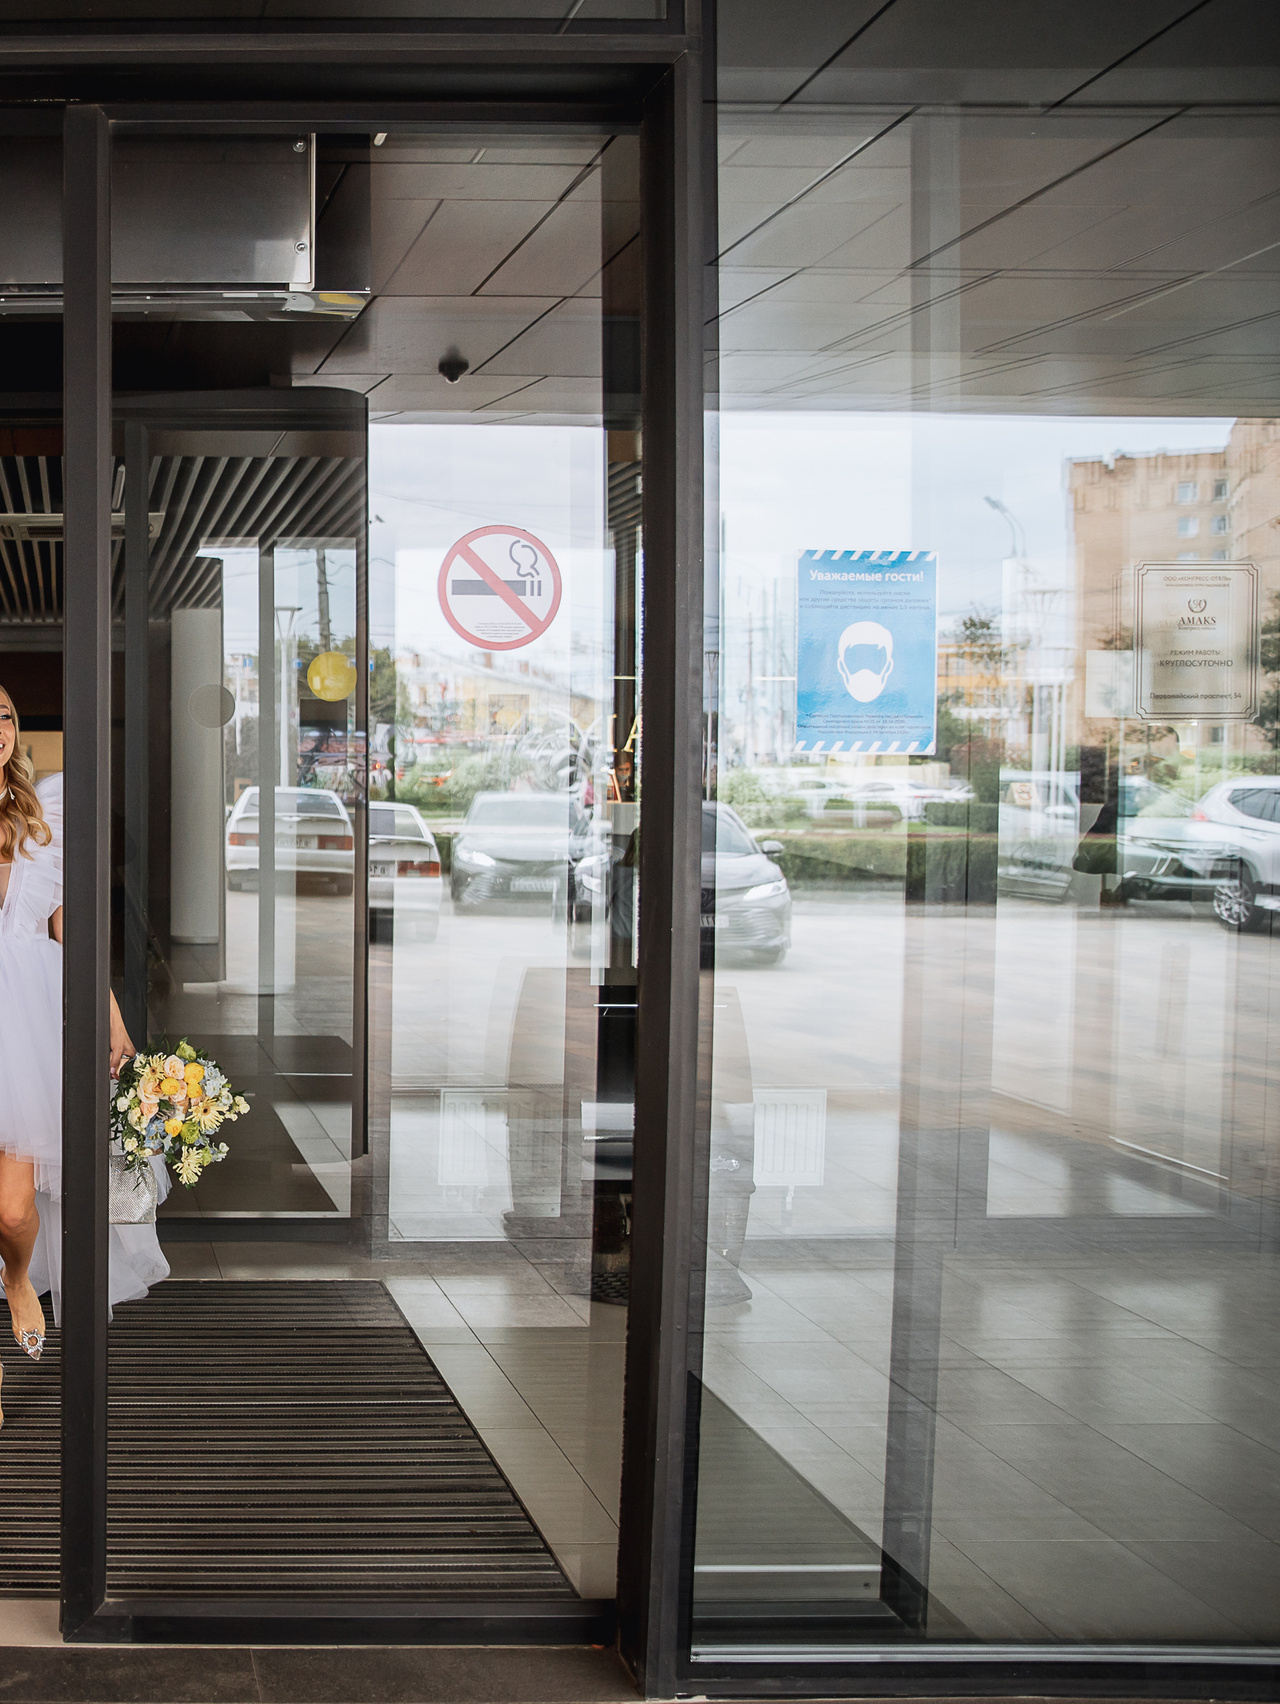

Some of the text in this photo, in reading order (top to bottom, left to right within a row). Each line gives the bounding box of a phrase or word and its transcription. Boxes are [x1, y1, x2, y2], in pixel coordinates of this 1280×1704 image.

[809, 569, 924, 582] Уважаемые гости!
[1178, 616, 1217, 625] AMAKS
[1159, 659, 1234, 667] КРУГЛОСУТОЧНО
[1150, 691, 1199, 699] Первомайский
